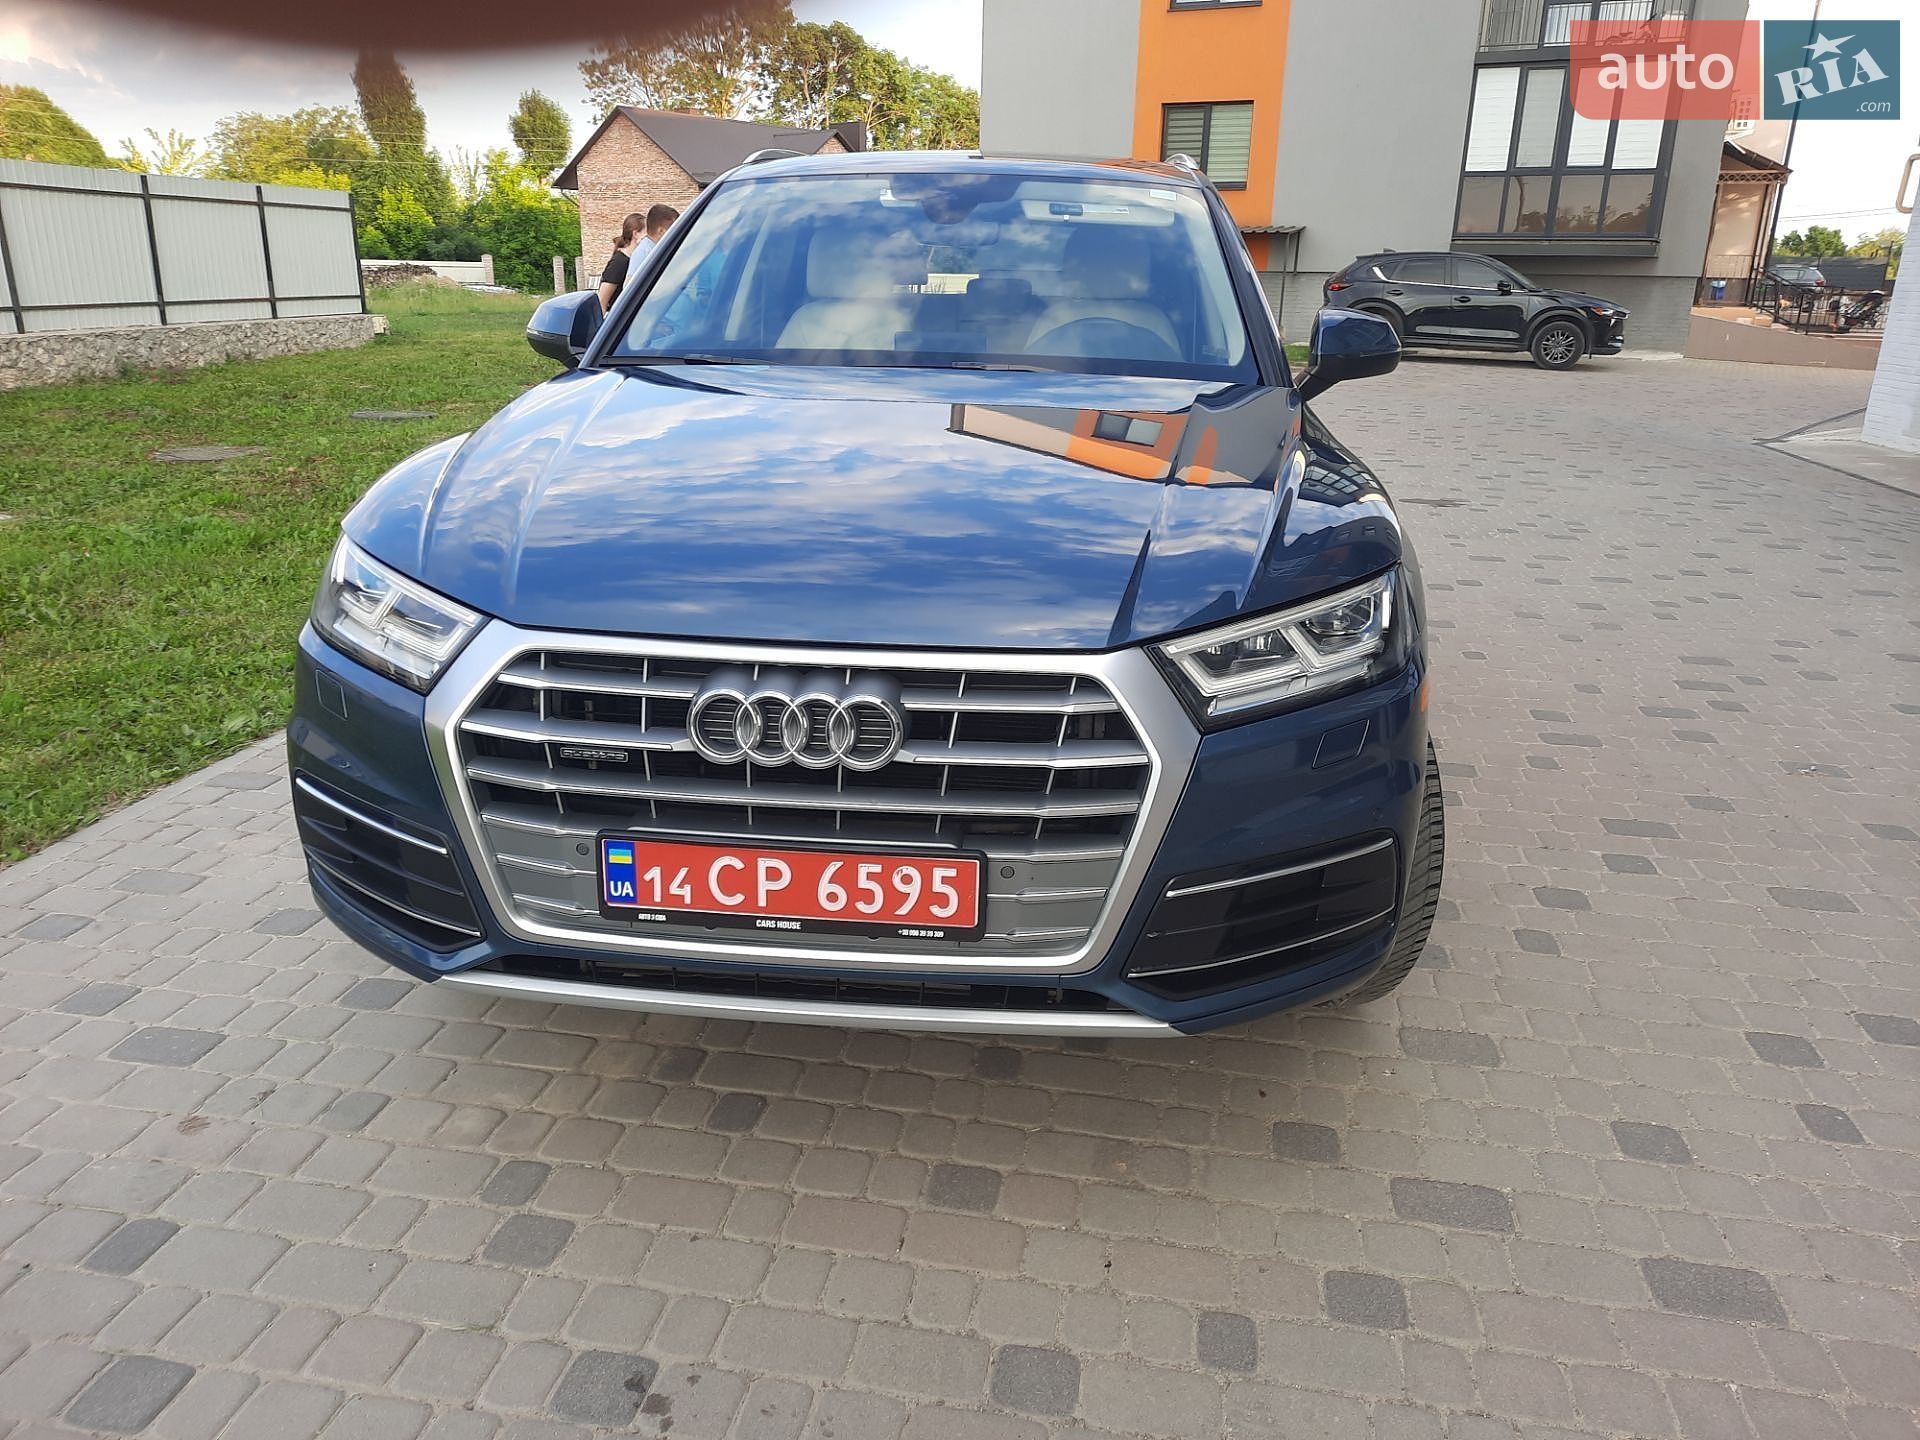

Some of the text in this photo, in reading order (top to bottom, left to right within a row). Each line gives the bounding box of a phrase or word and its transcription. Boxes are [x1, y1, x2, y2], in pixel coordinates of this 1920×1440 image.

[610, 881, 634, 897] UA
[643, 856, 959, 918] 14 CP 6595
[756, 920, 802, 929] CARS HOUSE
